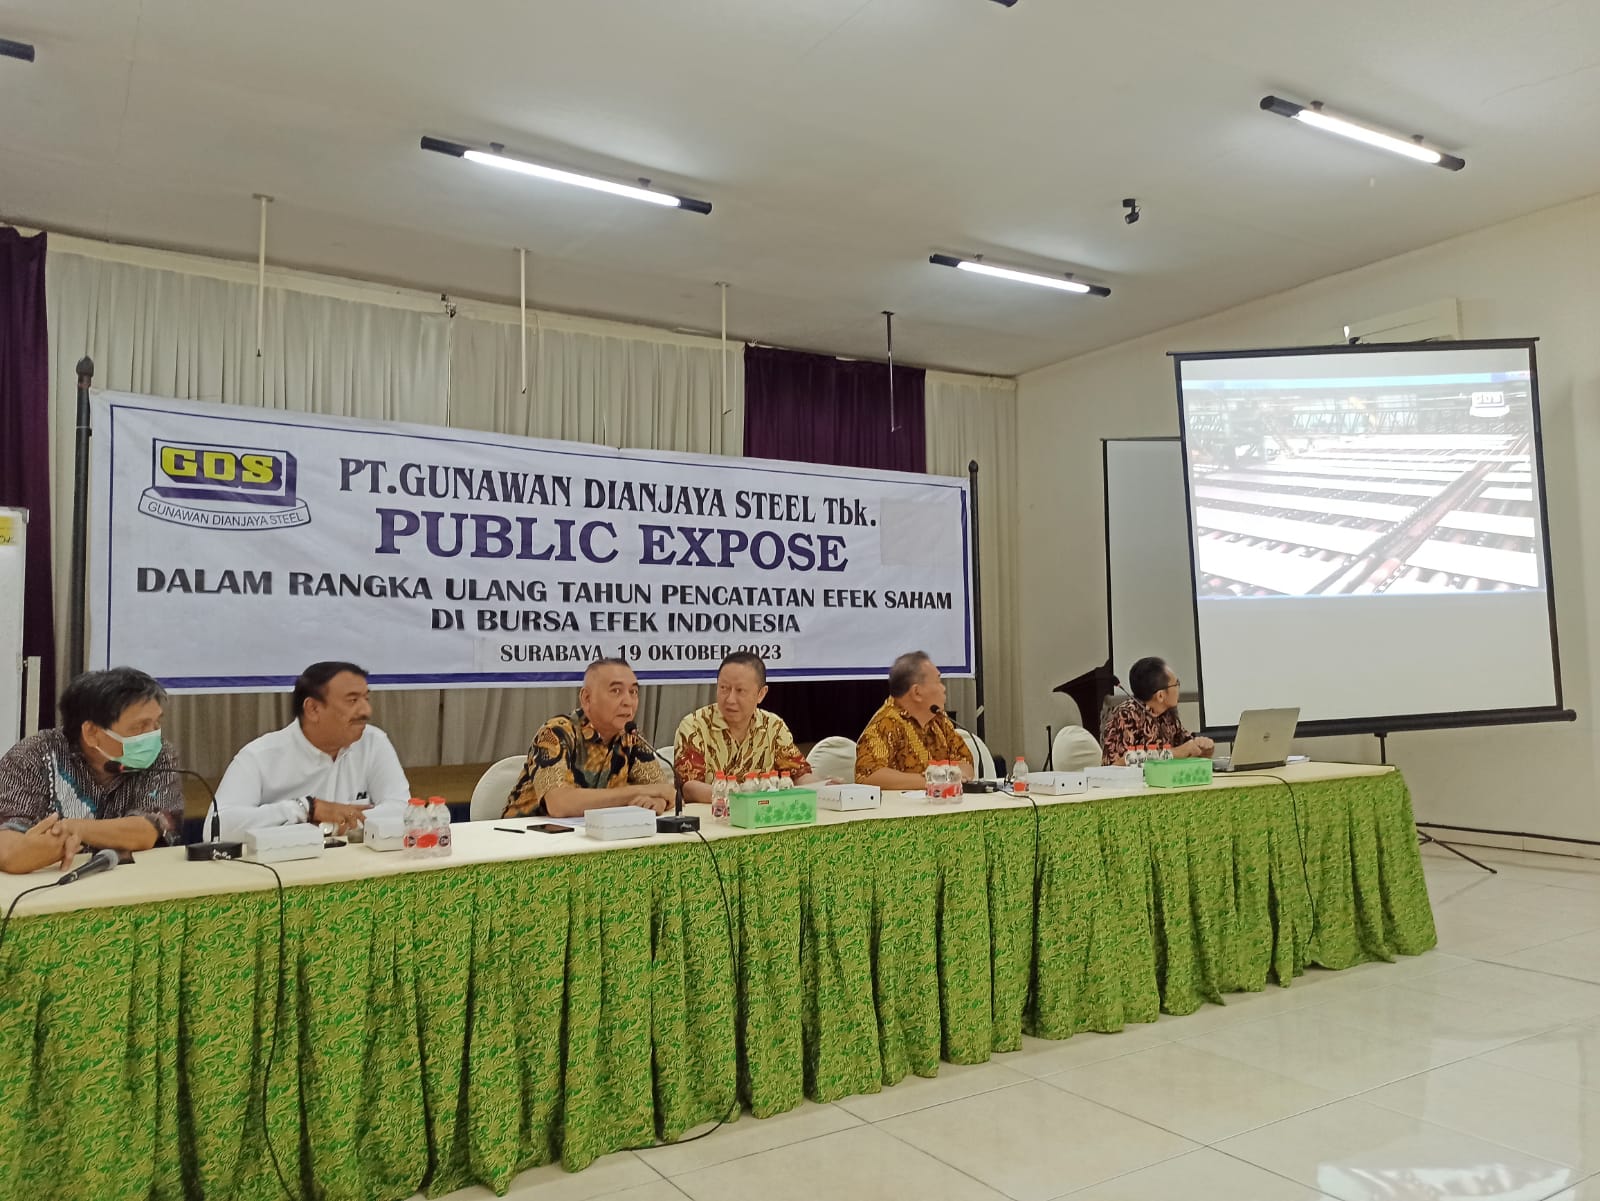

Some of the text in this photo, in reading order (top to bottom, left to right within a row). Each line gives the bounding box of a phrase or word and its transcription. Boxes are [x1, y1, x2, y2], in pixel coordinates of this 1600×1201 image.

[161, 446, 274, 484] GDS
[340, 458, 877, 527] PT.GUNAWAN DIANJAYA STEEL Tbk.
[148, 501, 304, 527] GUNAWAN DIANJAYA STEEL
[375, 507, 849, 572] PUBLIC EXPOSE
[137, 567, 953, 611] DALAM RANGKA ULANG TAHUN PENCATATAN EFEK SAHAM
[431, 609, 801, 634] DI BURSA EFEK INDONESIA
[616, 645, 642, 662] 19
[648, 645, 733, 661] OKTOBER
